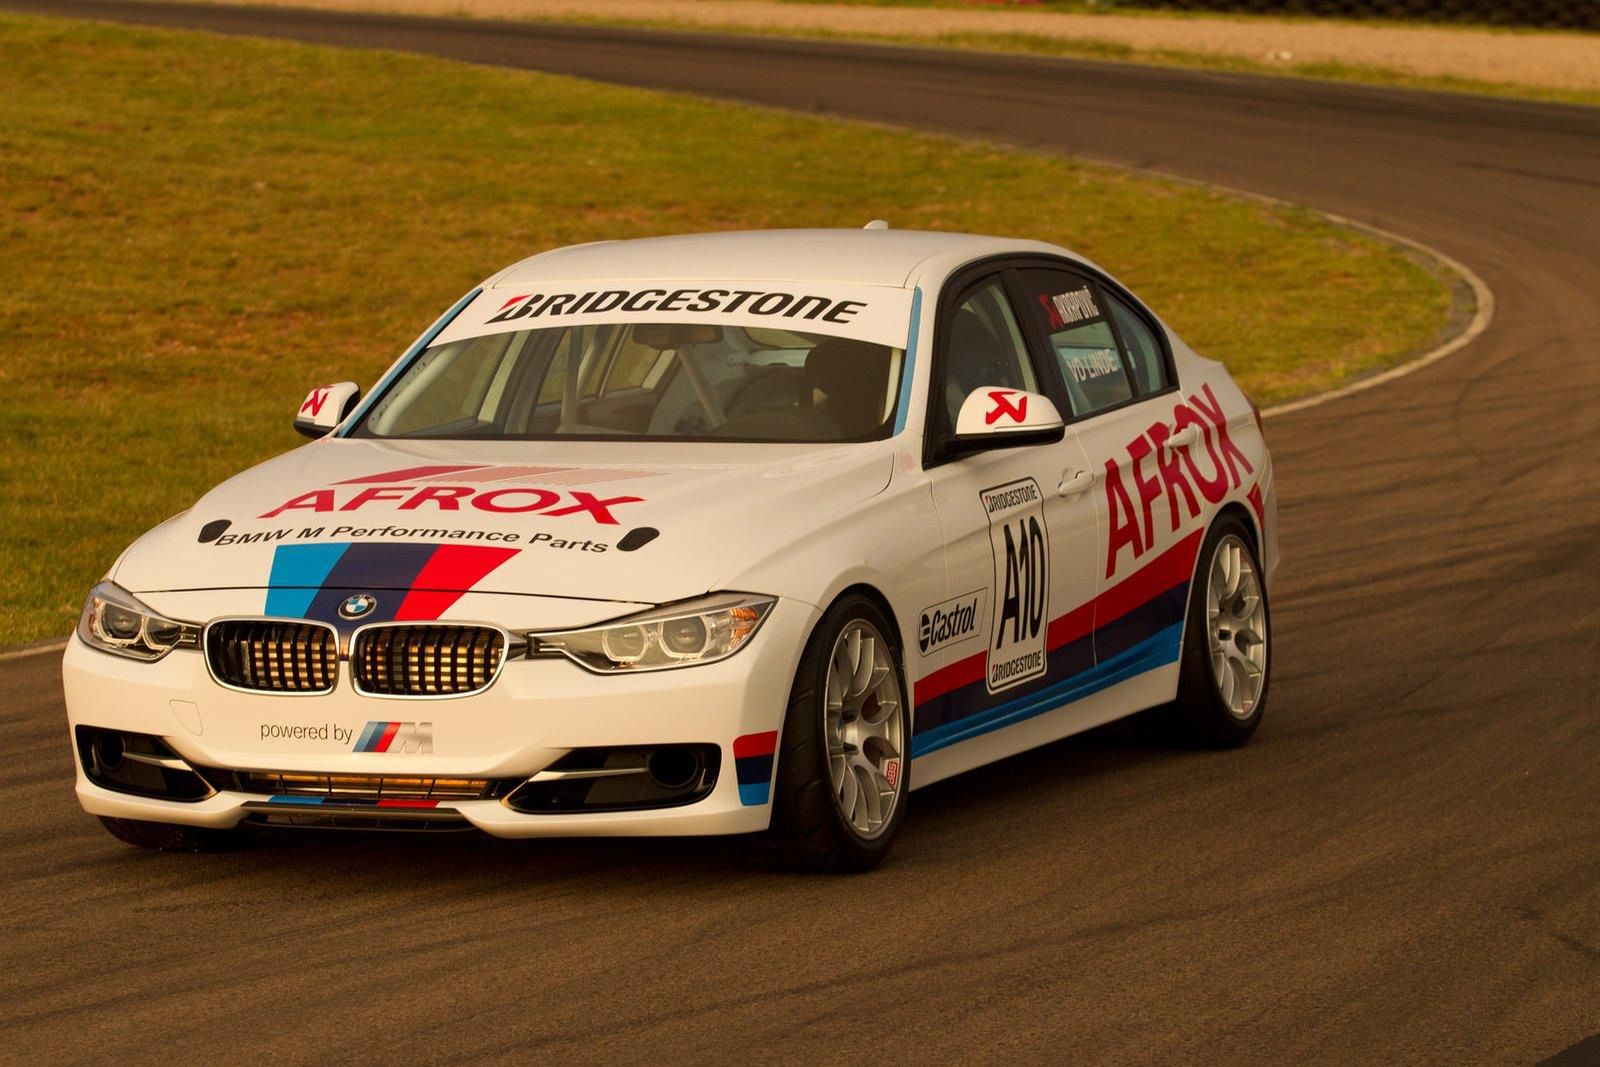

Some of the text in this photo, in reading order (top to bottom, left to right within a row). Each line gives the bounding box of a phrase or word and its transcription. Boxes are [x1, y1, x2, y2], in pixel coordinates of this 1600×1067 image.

[485, 289, 868, 325] BRIDGESTONE
[984, 484, 1039, 513] BRIDGESTONE
[1104, 382, 1254, 580] AFROX
[256, 487, 648, 525] AFROX
[214, 525, 609, 553] BMW M Performance Parts
[996, 515, 1046, 650] A10
[930, 597, 978, 646] Castrol
[991, 650, 1042, 683] BRIDGESTONE
[260, 723, 328, 740] powered
[333, 724, 353, 745] by
